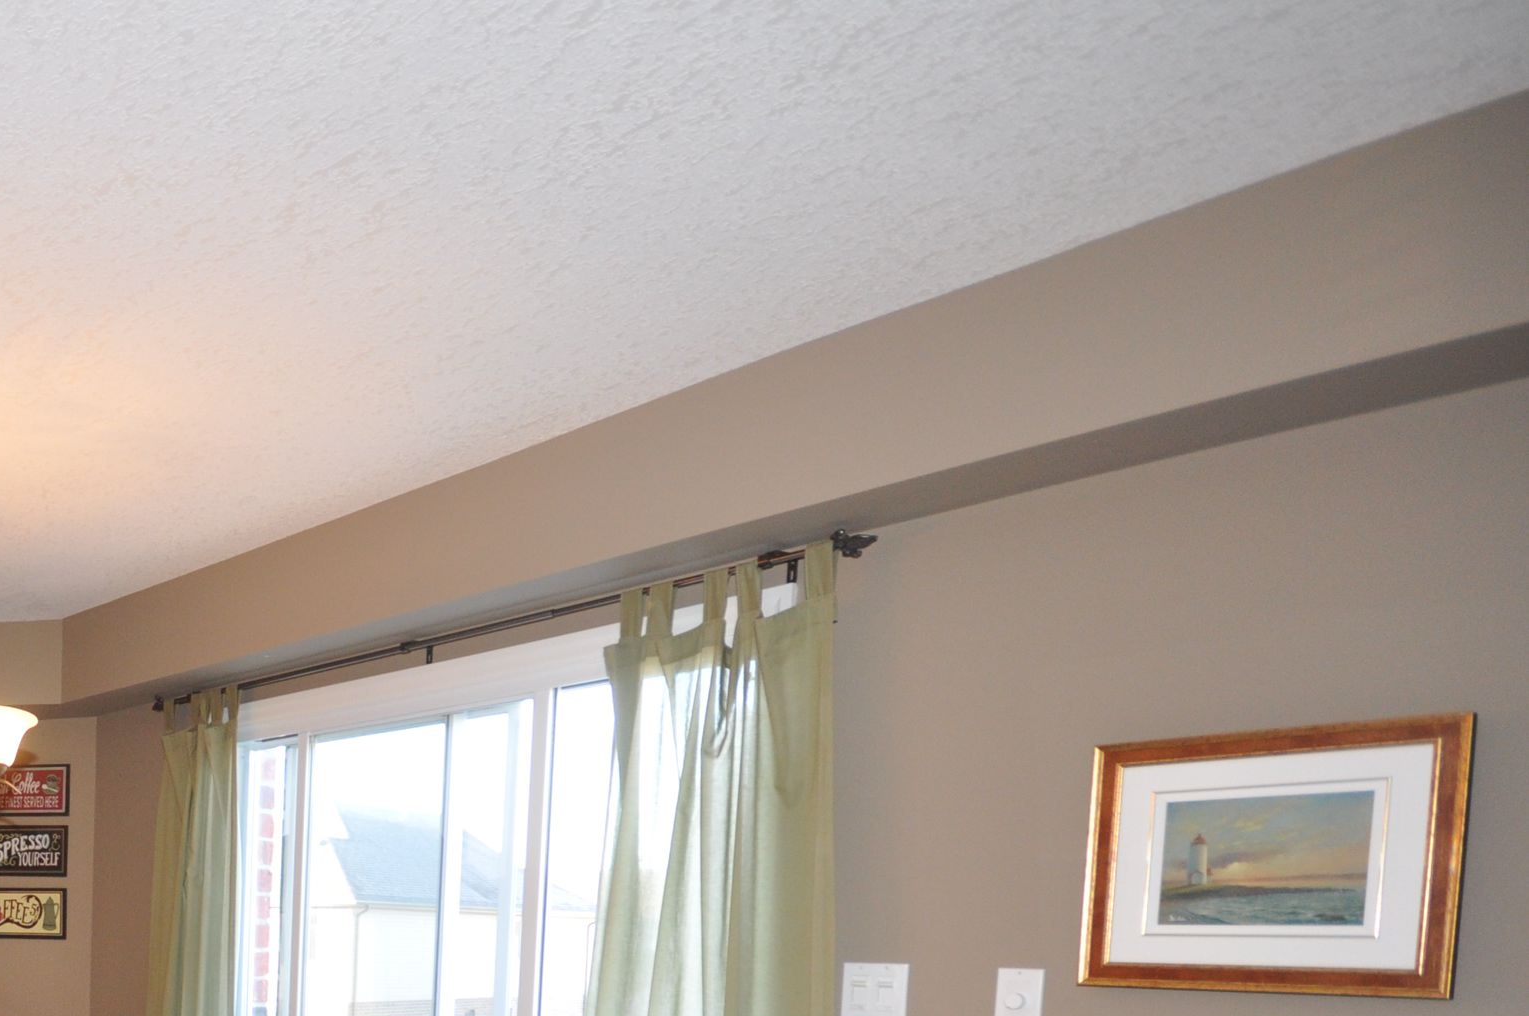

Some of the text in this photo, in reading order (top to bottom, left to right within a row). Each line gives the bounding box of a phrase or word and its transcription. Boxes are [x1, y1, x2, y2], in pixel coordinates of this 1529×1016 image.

[11, 772, 41, 795] Coffee
[23, 796, 44, 808] SERVED
[45, 796, 58, 808] HERE
[17, 852, 61, 867] YOURSELF
